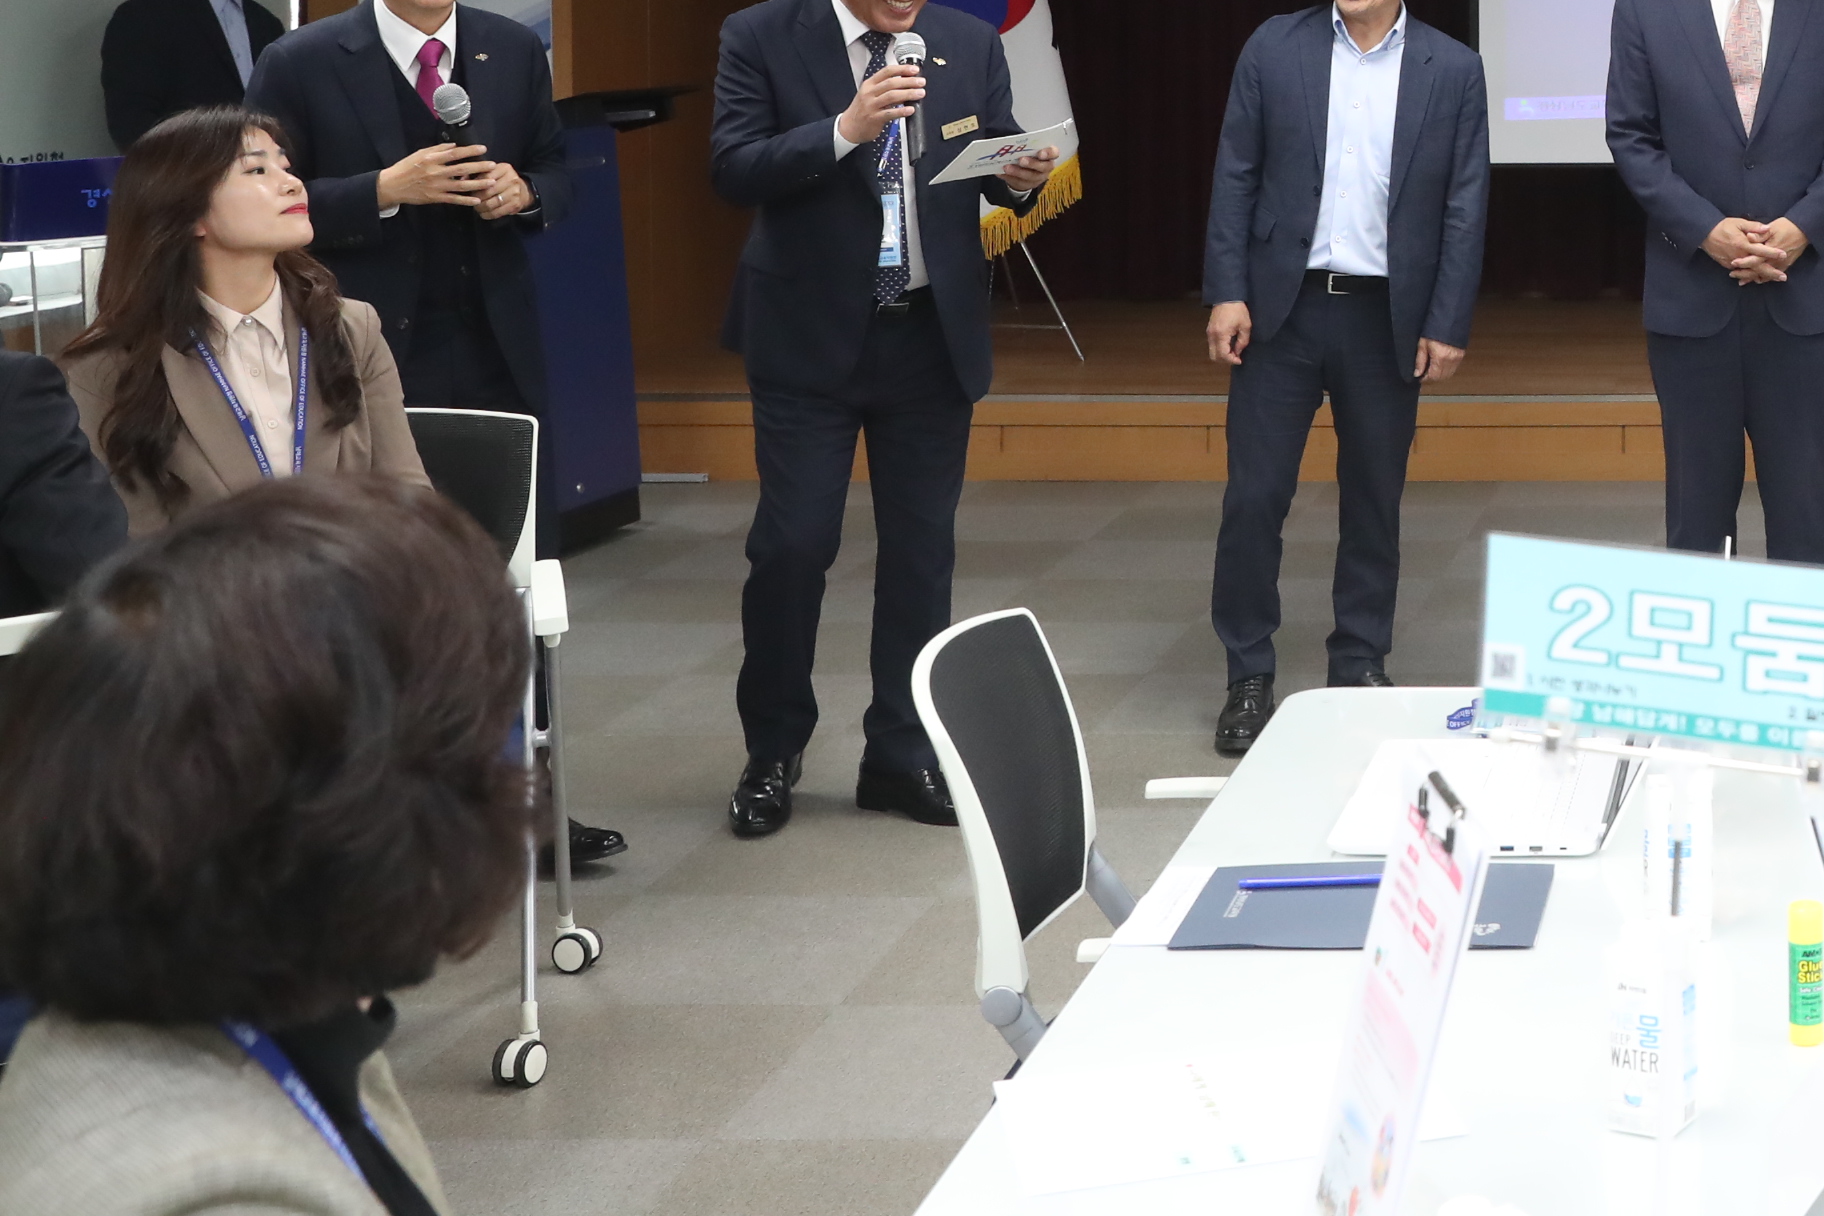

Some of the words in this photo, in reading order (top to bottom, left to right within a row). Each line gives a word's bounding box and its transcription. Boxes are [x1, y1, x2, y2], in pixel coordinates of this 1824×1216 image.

[297, 401, 306, 430] EDUCATION
[1798, 960, 1823, 972] Glue
[1611, 1046, 1659, 1074] WATER
